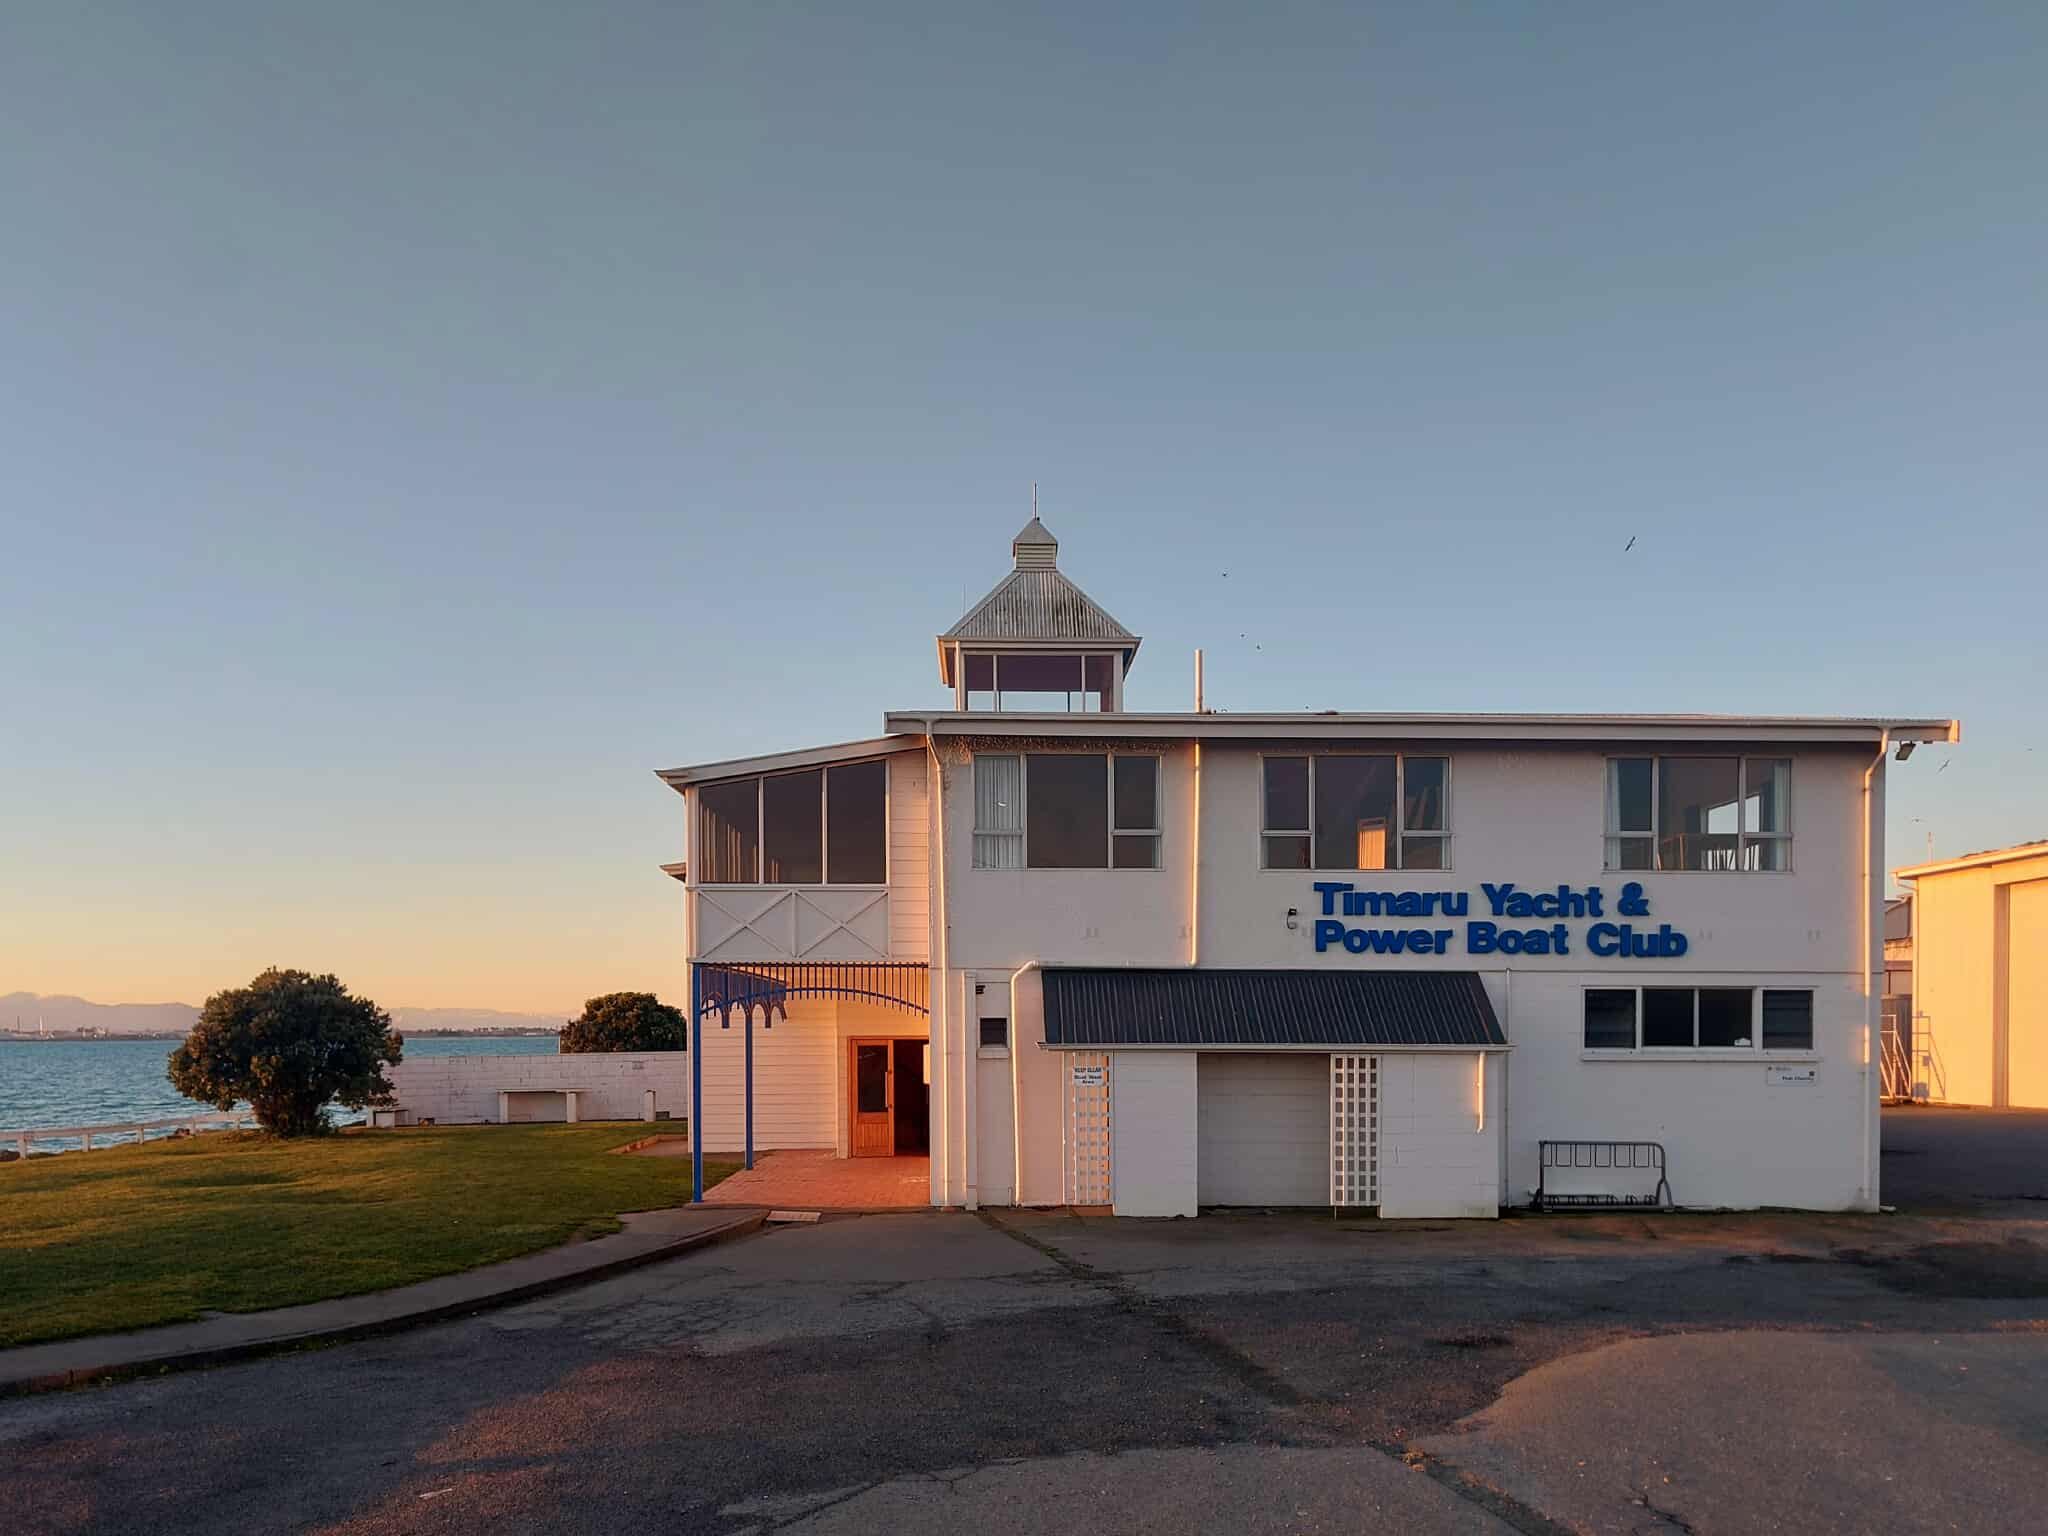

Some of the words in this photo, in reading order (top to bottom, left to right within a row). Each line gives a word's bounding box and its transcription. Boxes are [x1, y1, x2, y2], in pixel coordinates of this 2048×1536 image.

[1313, 882, 1468, 917] Timaru
[1482, 883, 1603, 918] Yacht
[1618, 882, 1649, 916] &
[1315, 919, 1454, 954] Power
[1467, 921, 1568, 955] Boat
[1586, 922, 1689, 957] Club
